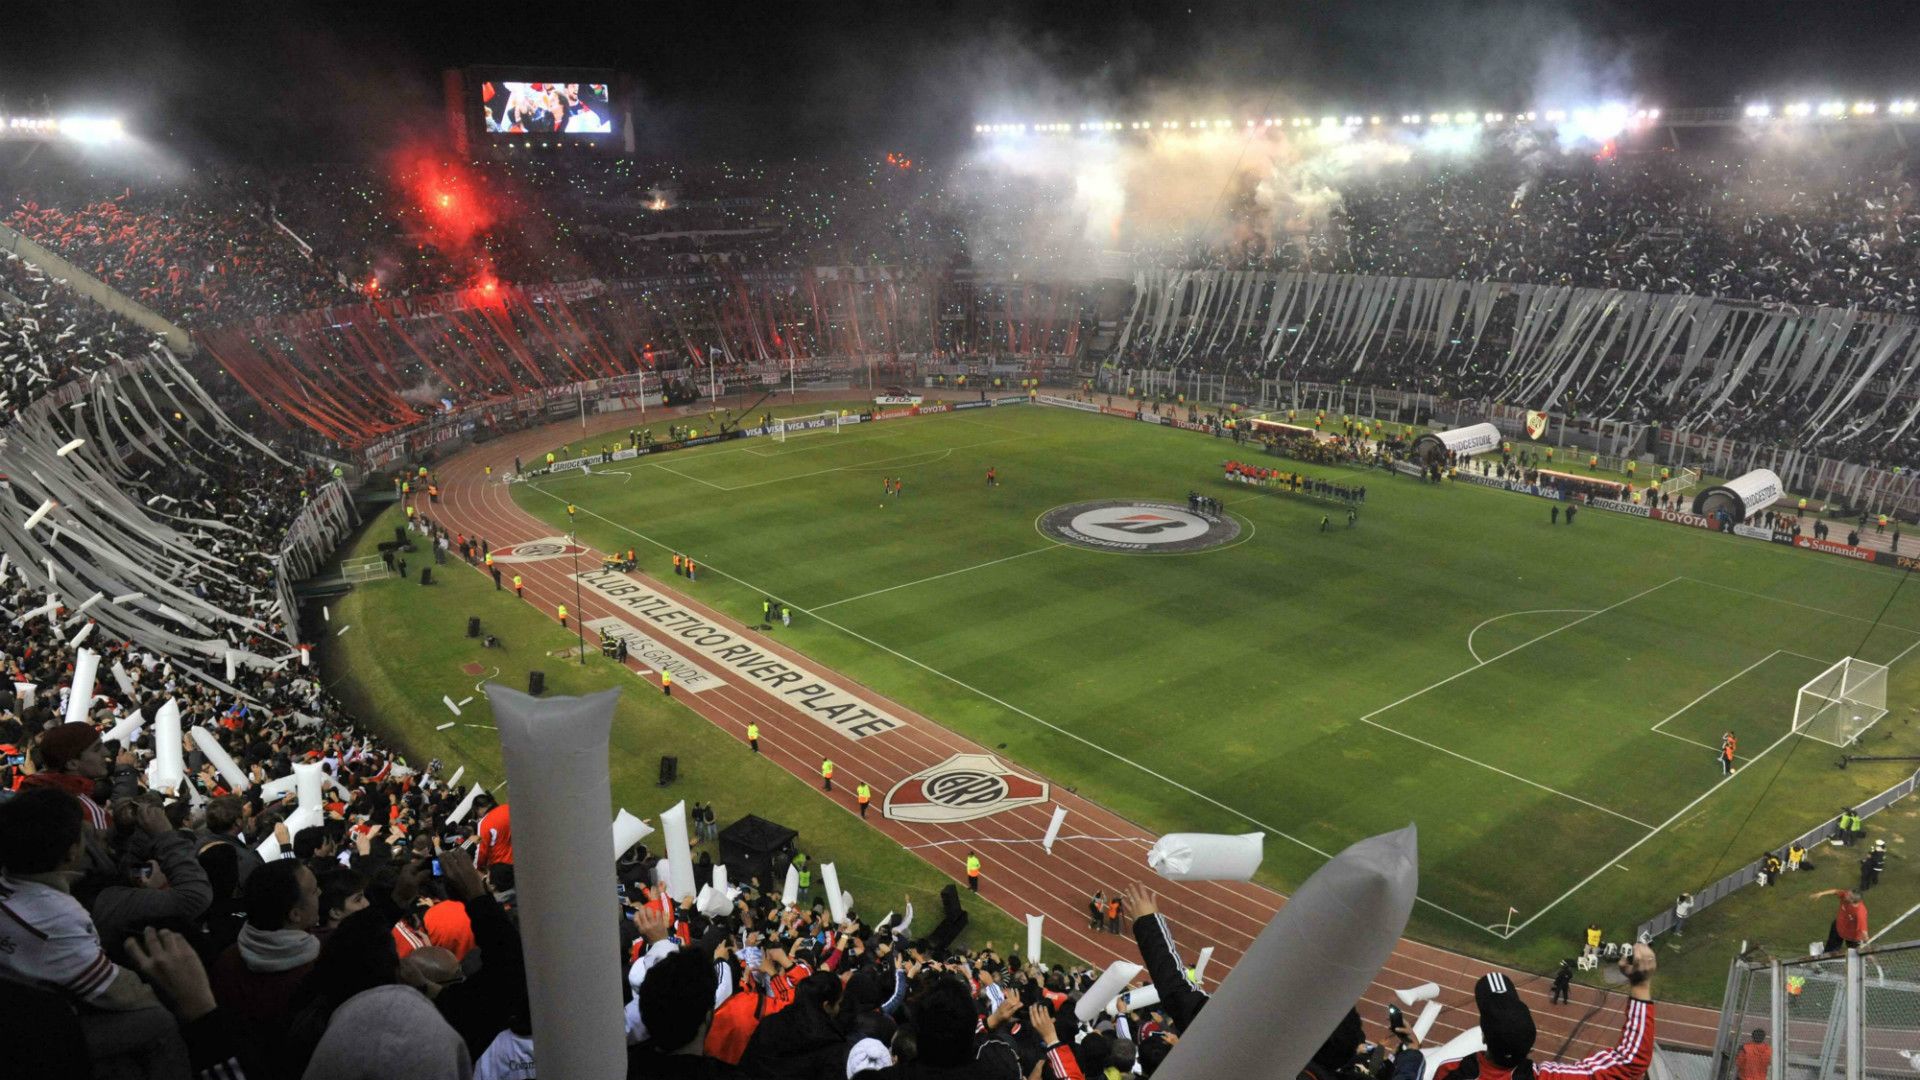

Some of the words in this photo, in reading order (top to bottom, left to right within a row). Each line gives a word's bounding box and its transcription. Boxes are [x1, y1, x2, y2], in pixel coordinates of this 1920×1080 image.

[919, 405, 947, 414] TOYOTA
[787, 422, 805, 431] VISA
[808, 419, 825, 428] VISA
[1177, 420, 1204, 432] TOYOTA
[745, 428, 762, 436] VISA
[1509, 482, 1532, 494] VISA
[1537, 487, 1560, 499] VISA
[1589, 497, 1649, 517] RIDGESTONE
[1660, 510, 1708, 528] TOYOTA
[1811, 540, 1868, 560] Santander
[578, 570, 640, 596] CLUB
[619, 595, 730, 646] ATLETICO
[712, 644, 803, 688] RIVER
[784, 683, 896, 737] PLATE
[643, 649, 708, 684] GRANDE
